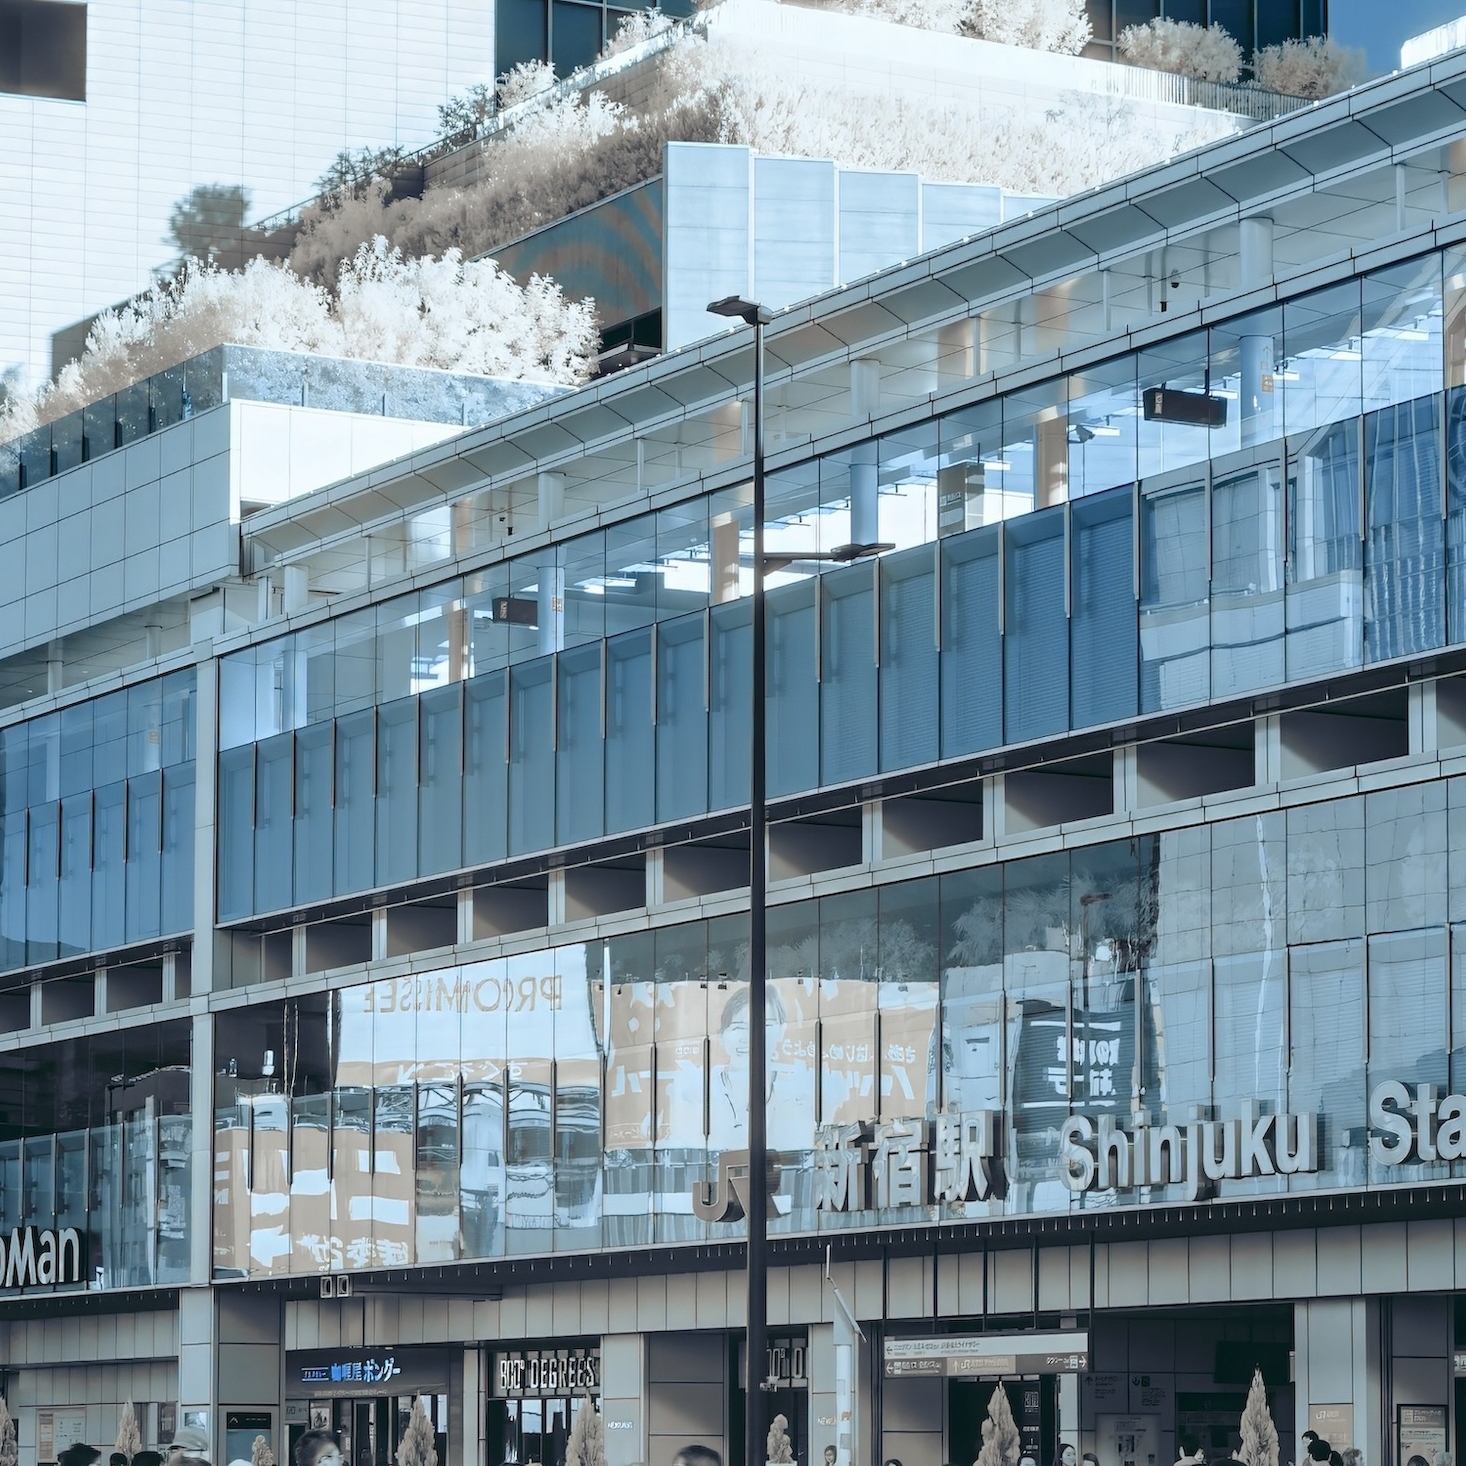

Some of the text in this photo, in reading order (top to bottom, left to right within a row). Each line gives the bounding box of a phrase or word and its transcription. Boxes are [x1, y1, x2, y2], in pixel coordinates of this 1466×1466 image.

[815, 1111, 991, 1211] 新宿駅
[1060, 1100, 1319, 1201] Shinjuku
[530, 1356, 595, 1389] DEGREES
